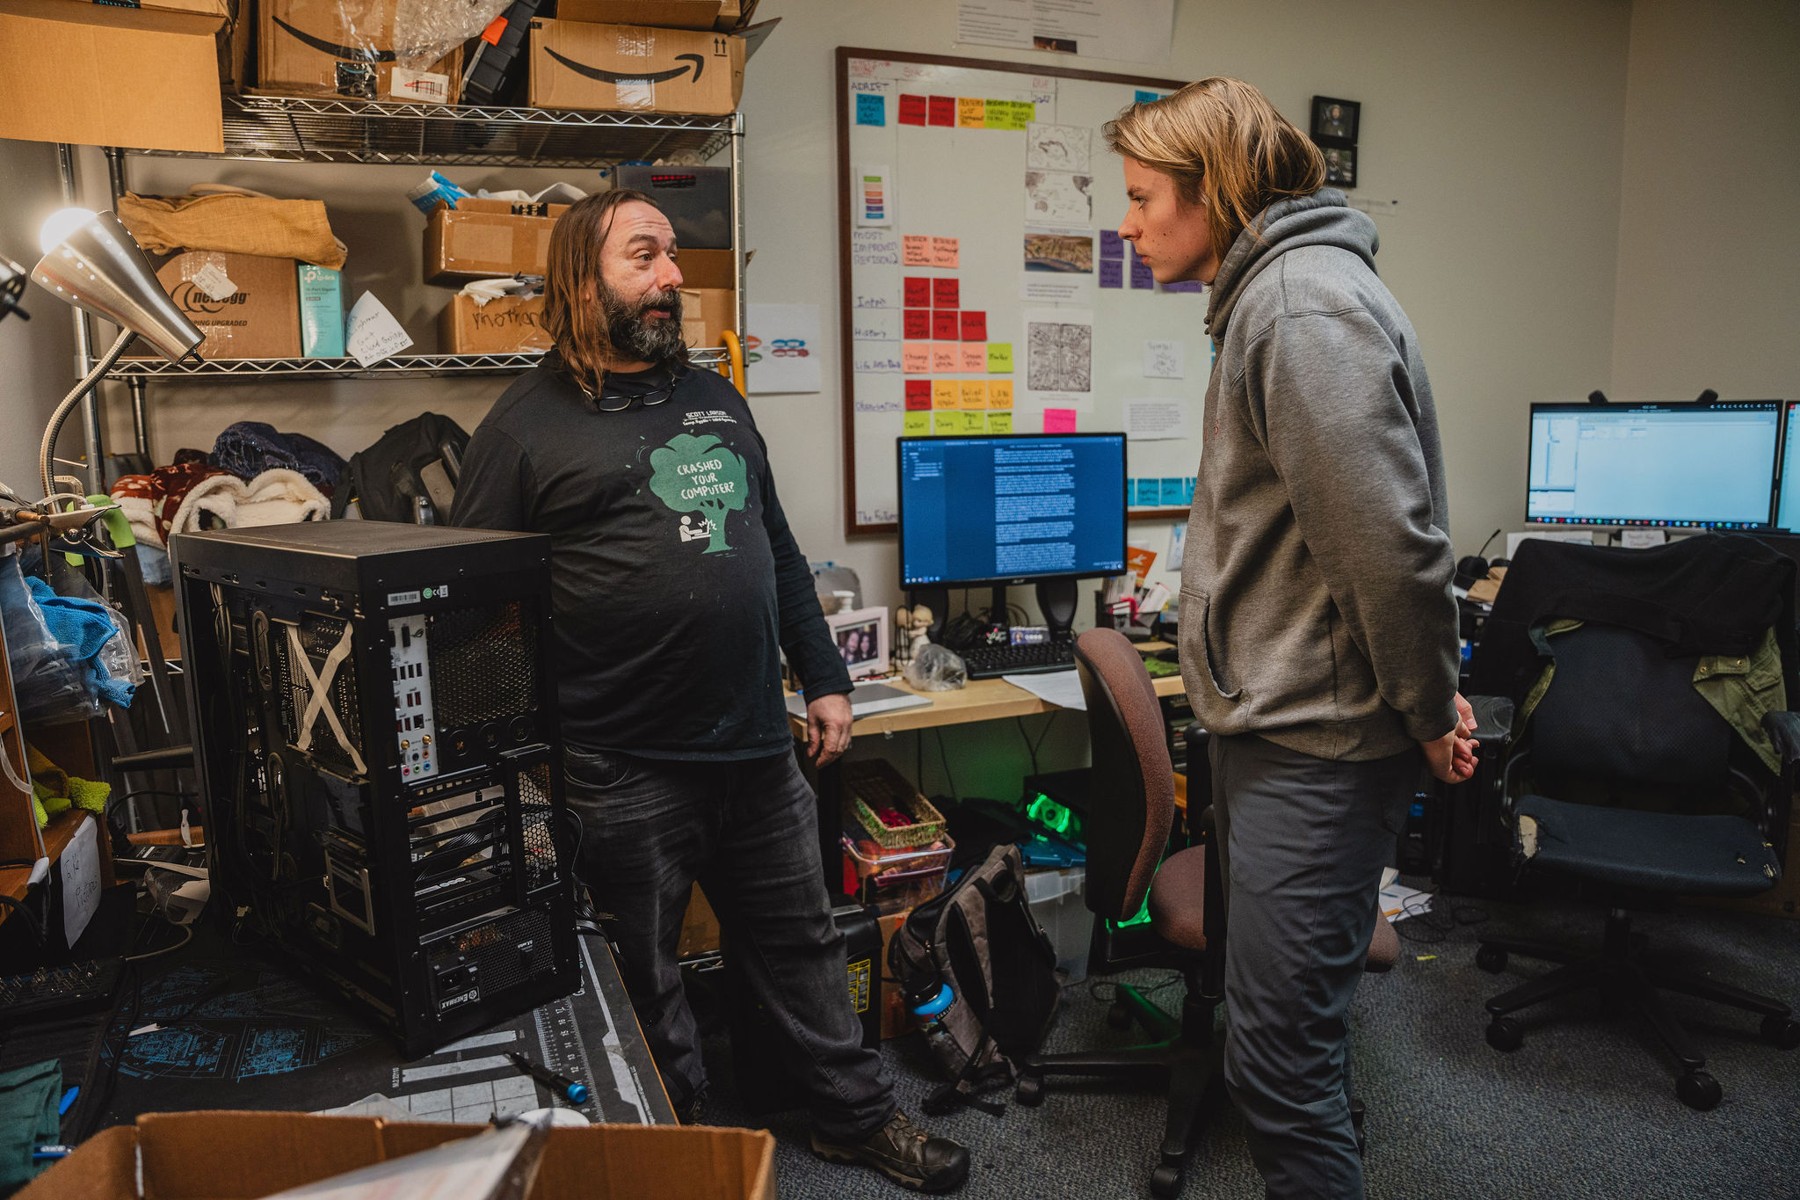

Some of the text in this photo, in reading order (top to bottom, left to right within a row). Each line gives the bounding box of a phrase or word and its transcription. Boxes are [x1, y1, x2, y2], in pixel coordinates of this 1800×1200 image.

[677, 459, 722, 475] CRASHED
[691, 473, 718, 485] YOUR
[681, 481, 734, 499] COMPUTER?
